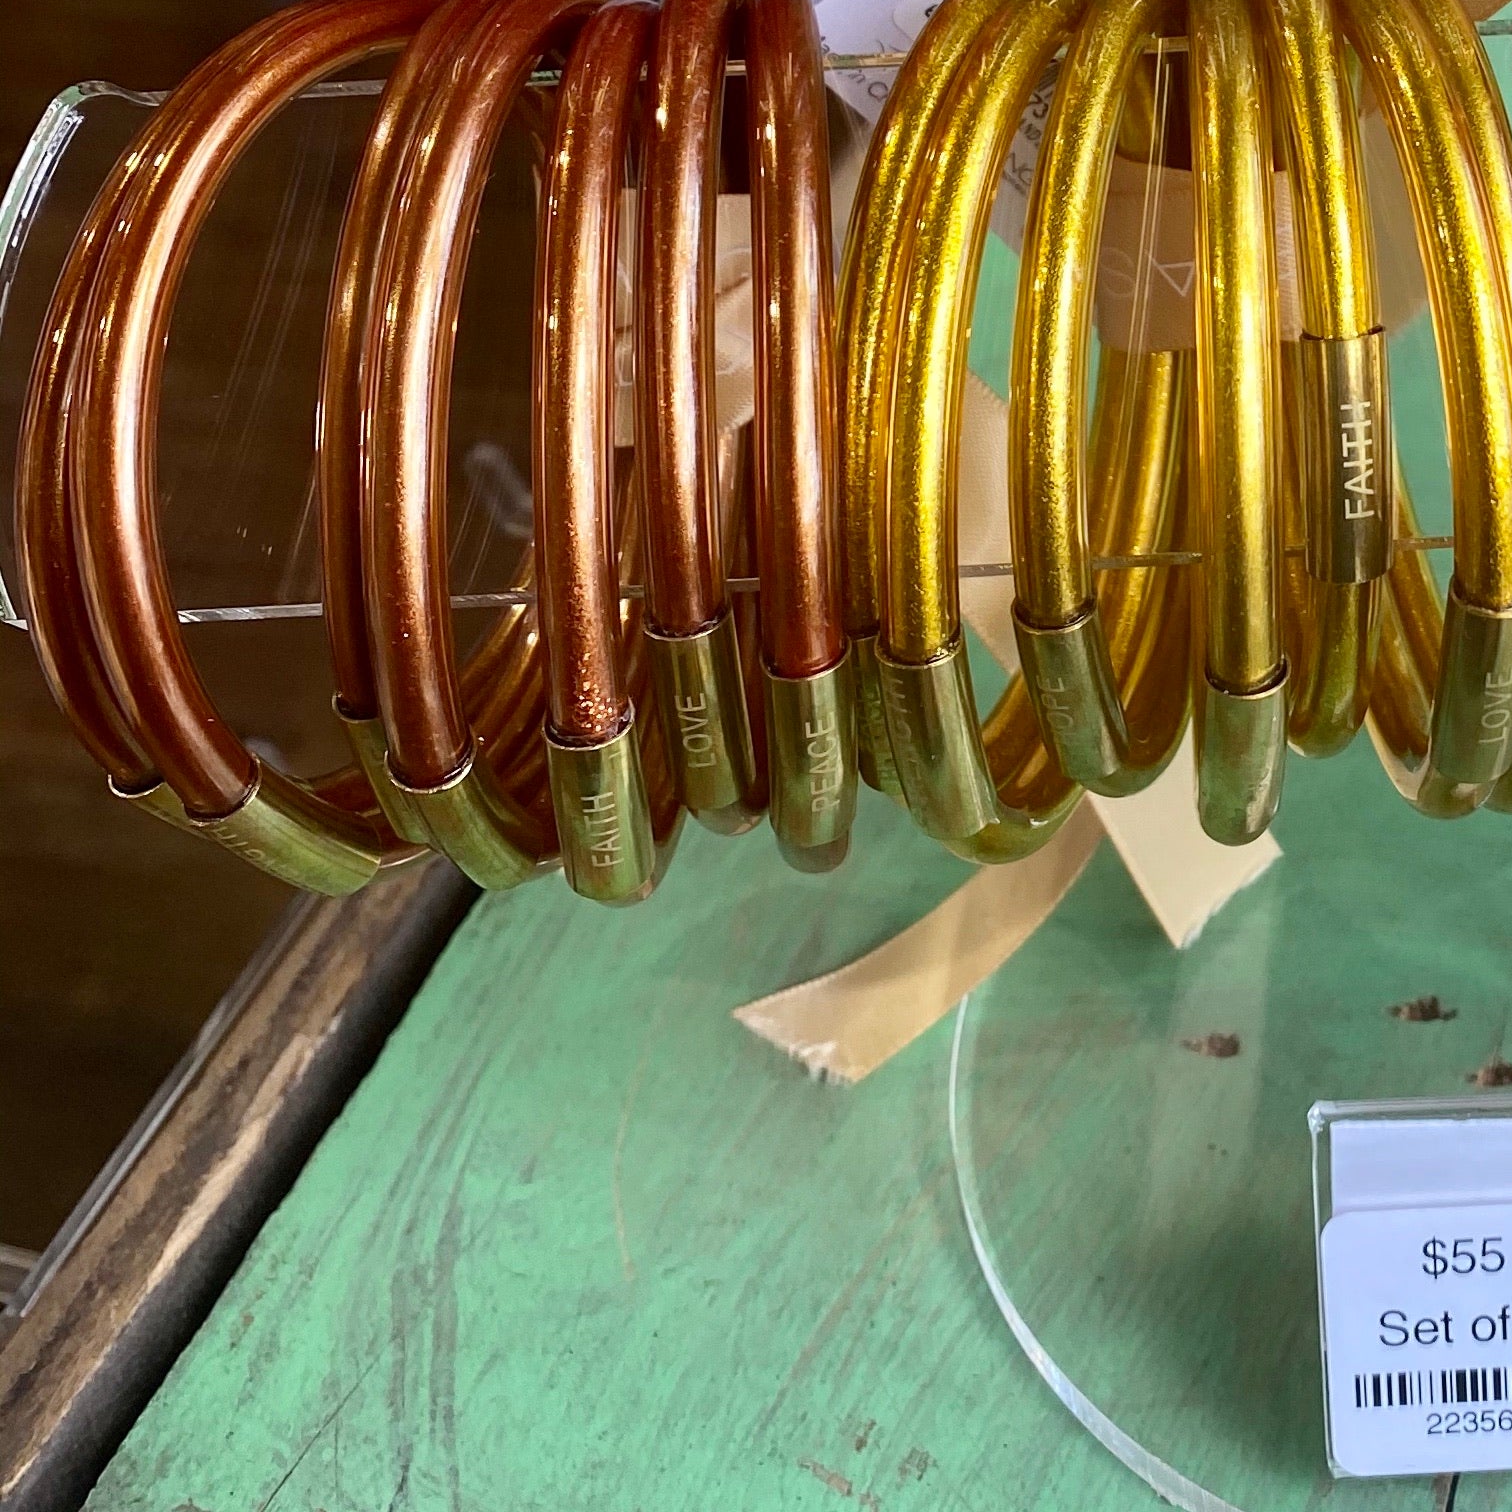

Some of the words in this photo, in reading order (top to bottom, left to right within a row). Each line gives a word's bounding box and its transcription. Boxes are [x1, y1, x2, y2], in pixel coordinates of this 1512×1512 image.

[1339, 400, 1376, 520] FAITH
[674, 692, 717, 769] LOVE
[804, 710, 842, 815] PEACE
[580, 790, 625, 870] FAITH
[1420, 1235, 1507, 1279] $55
[1378, 1309, 1454, 1348] Set
[1470, 1305, 1511, 1344] of
